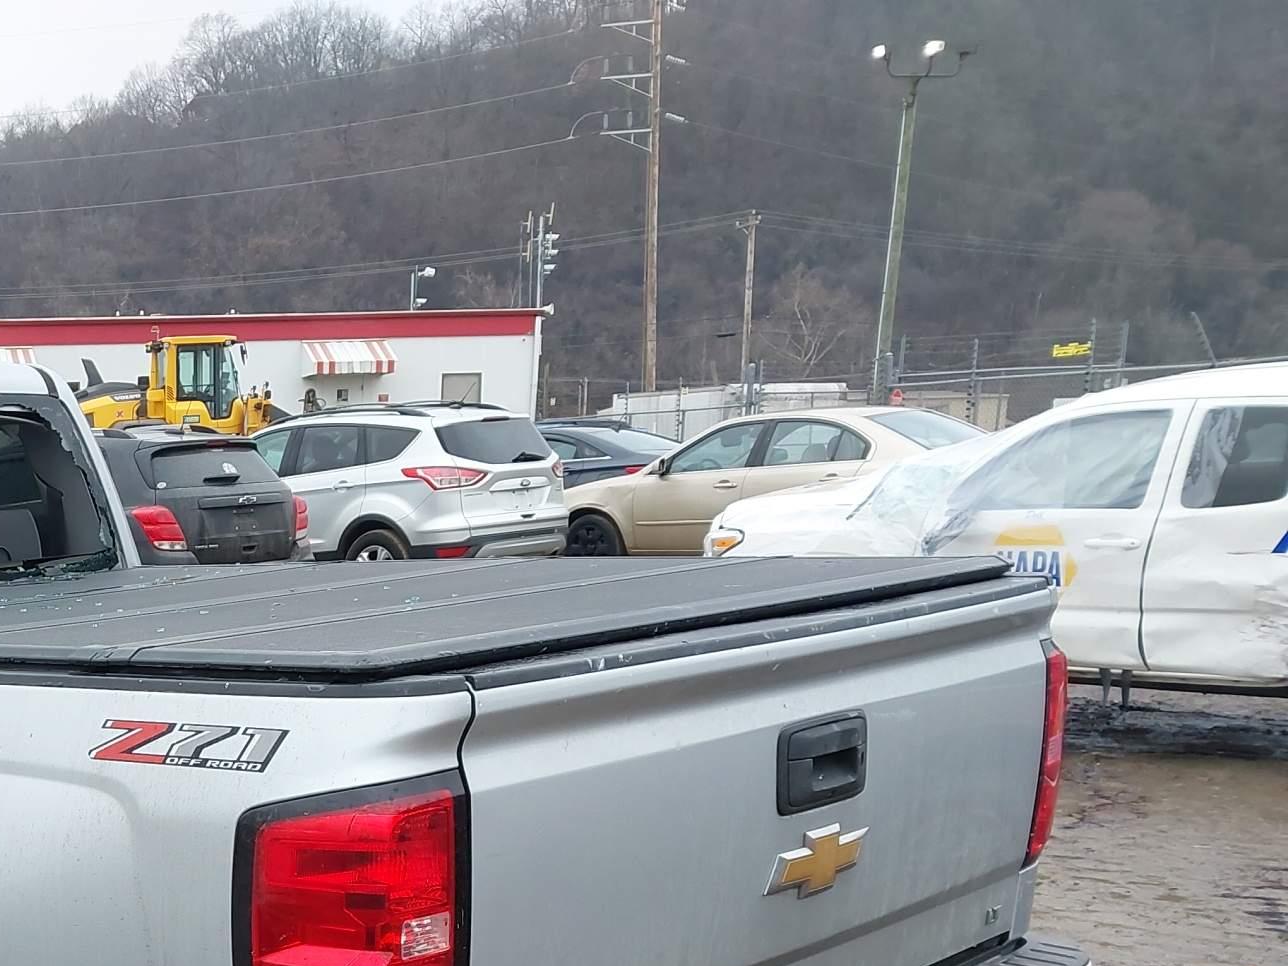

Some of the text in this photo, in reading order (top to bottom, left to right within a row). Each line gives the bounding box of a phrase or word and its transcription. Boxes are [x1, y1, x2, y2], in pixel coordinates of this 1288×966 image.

[88, 719, 290, 765] Z71
[165, 756, 263, 772] OFF ROAD
